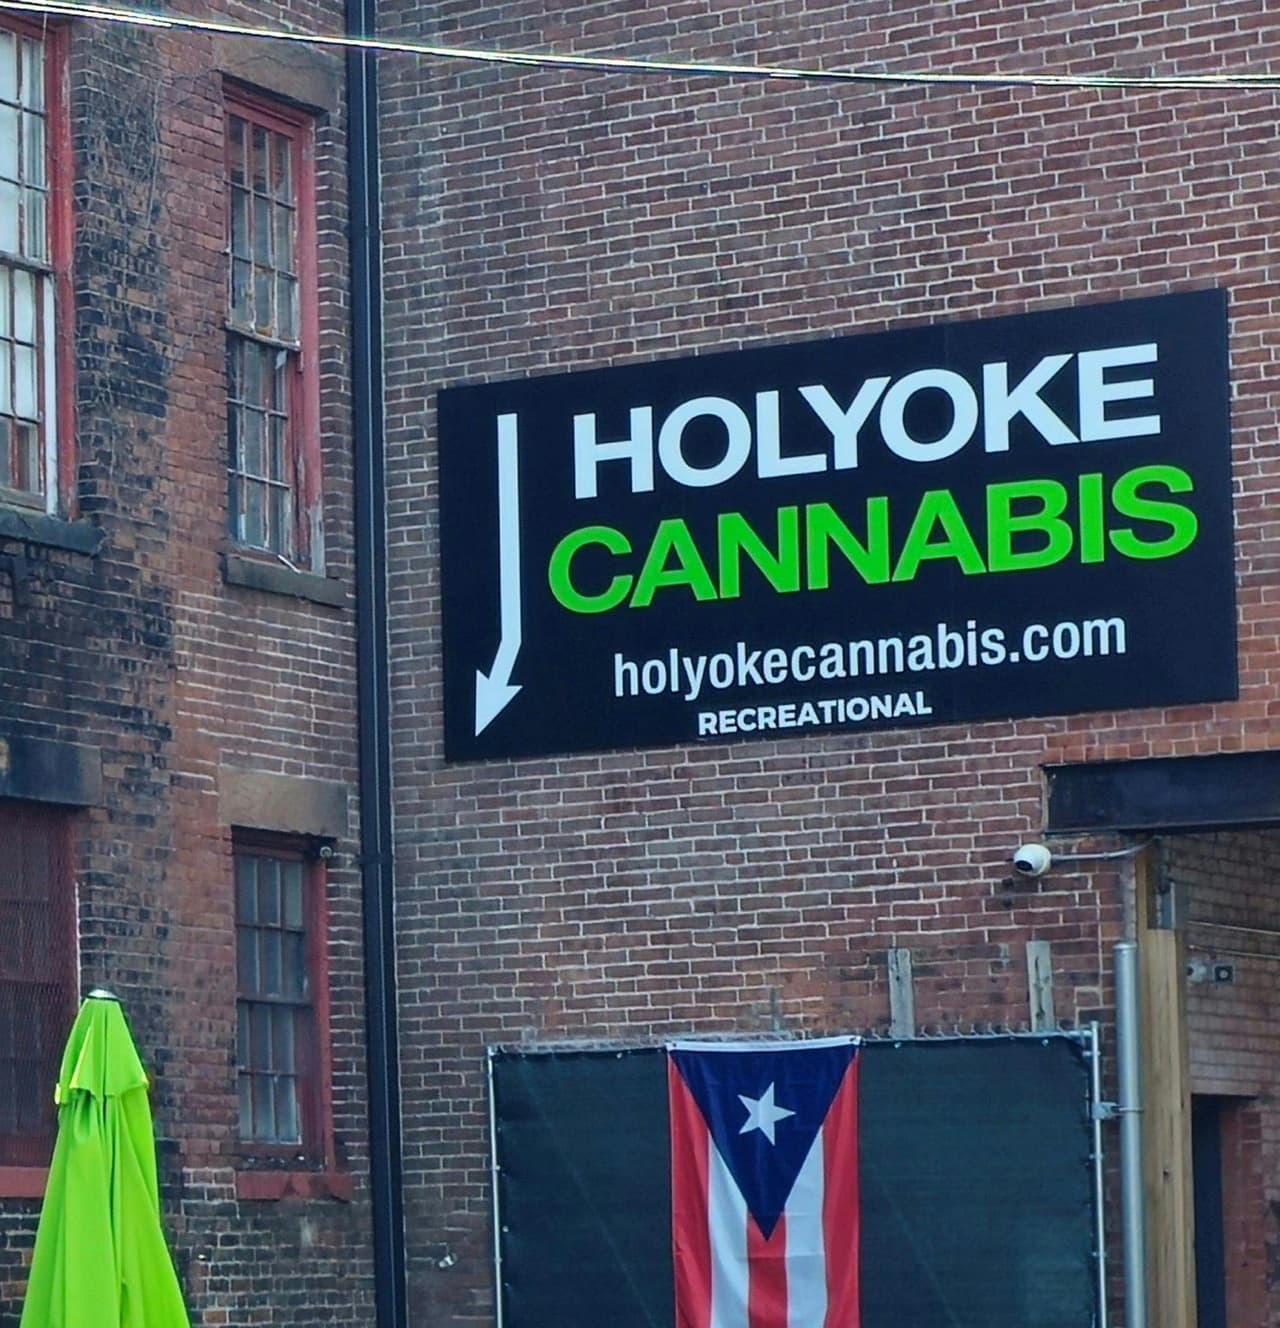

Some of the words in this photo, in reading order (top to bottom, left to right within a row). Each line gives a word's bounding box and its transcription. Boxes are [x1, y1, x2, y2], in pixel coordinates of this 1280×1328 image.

[573, 343, 1162, 499] HOLYOKE
[548, 465, 1200, 615] CANNABIS
[613, 616, 1127, 701] holyokecannabis.com
[697, 690, 933, 736] RECREATIONAL
